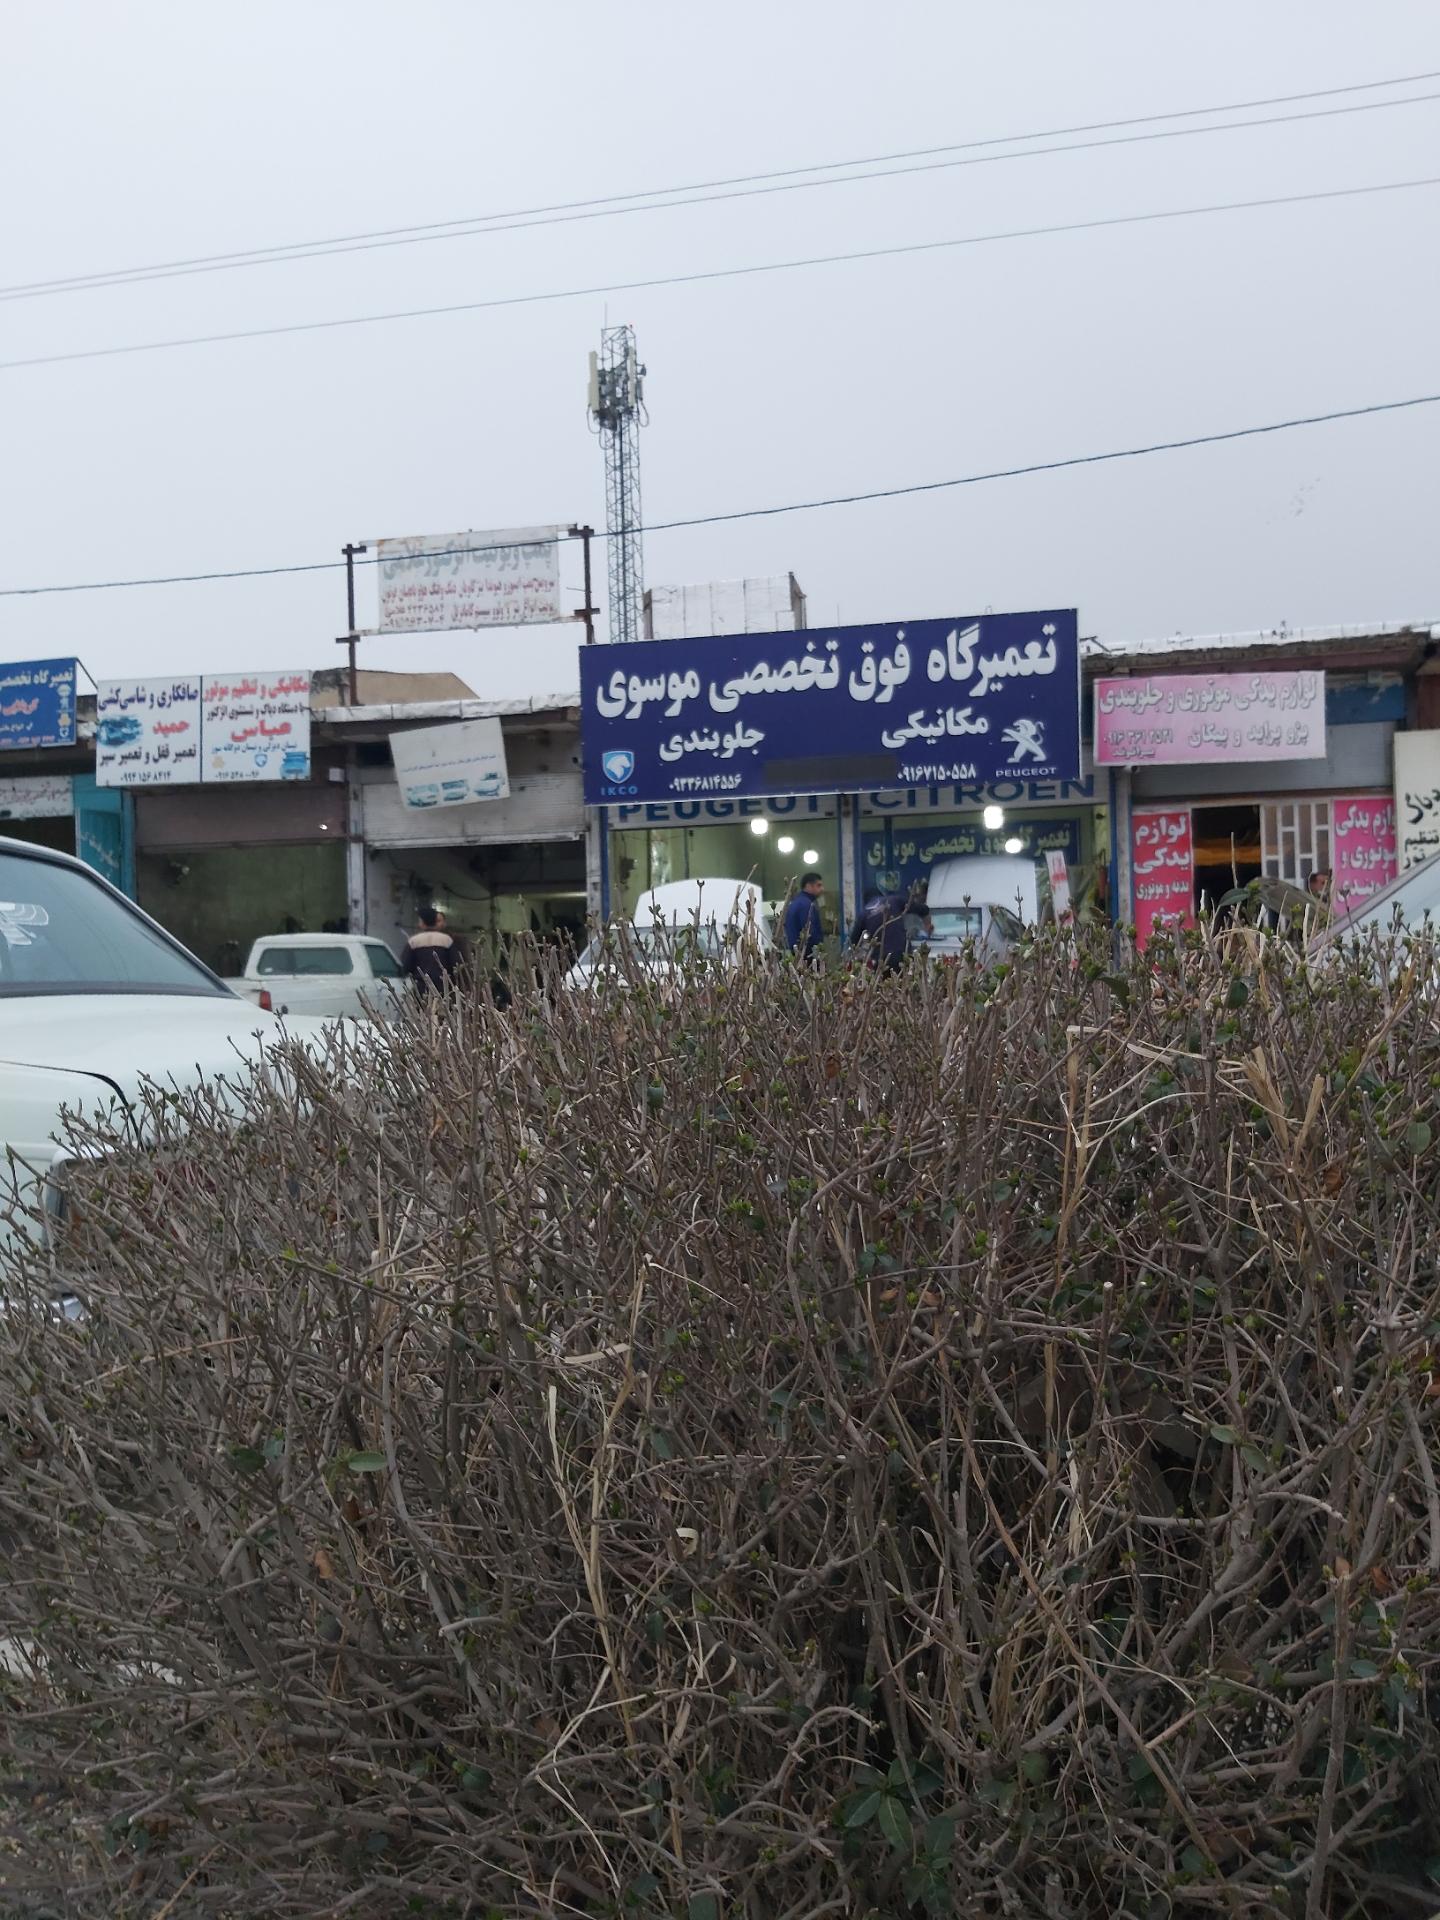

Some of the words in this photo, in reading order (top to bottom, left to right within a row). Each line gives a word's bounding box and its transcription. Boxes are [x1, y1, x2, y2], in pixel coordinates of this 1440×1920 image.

[849, 630, 911, 703] فوق
[927, 623, 1057, 697] تعمیرگاه
[232, 678, 258, 700] تنظیم
[269, 675, 311, 699] مکانیکی
[708, 640, 840, 713] تخصصی
[149, 692, 155, 709] و
[157, 682, 199, 709] صافکاری
[203, 680, 229, 702] موتور
[260, 684, 266, 700] و
[596, 669, 700, 720] موسوی
[1099, 681, 1164, 715] جلوبندی
[1166, 690, 1175, 713] و
[1177, 678, 1231, 713] موتوری
[1234, 677, 1277, 710] یدکی
[1277, 674, 1317, 711] لوازم
[152, 720, 190, 738] حمید
[881, 707, 989, 749] مکانیکی
[1187, 723, 1230, 748] پیکان
[1232, 729, 1242, 747] و
[1249, 720, 1282, 747] پراید
[1287, 721, 1309, 746] پژو
[152, 743, 170, 764] قفل
[173, 743, 196, 764] تعمیر
[659, 720, 766, 762] جلوبندی
[118, 746, 142, 766] تعمیر
[144, 752, 150, 764] و
[897, 763, 977, 782] ۰۹۱۶۷۱۵۰۵۵۸
[995, 766, 1058, 778] PEUGEOT
[601, 786, 638, 796] IKCO
[618, 795, 819, 823] PEUGEOT
[869, 774, 1095, 809] CITROEN
[1135, 815, 1186, 846] لوازم
[1335, 805, 1370, 837] یدکی
[919, 829, 975, 864] تخصصی
[1133, 847, 1190, 875] یدکی
[1136, 877, 1164, 900] موتوری
[1165, 883, 1170, 899] و
